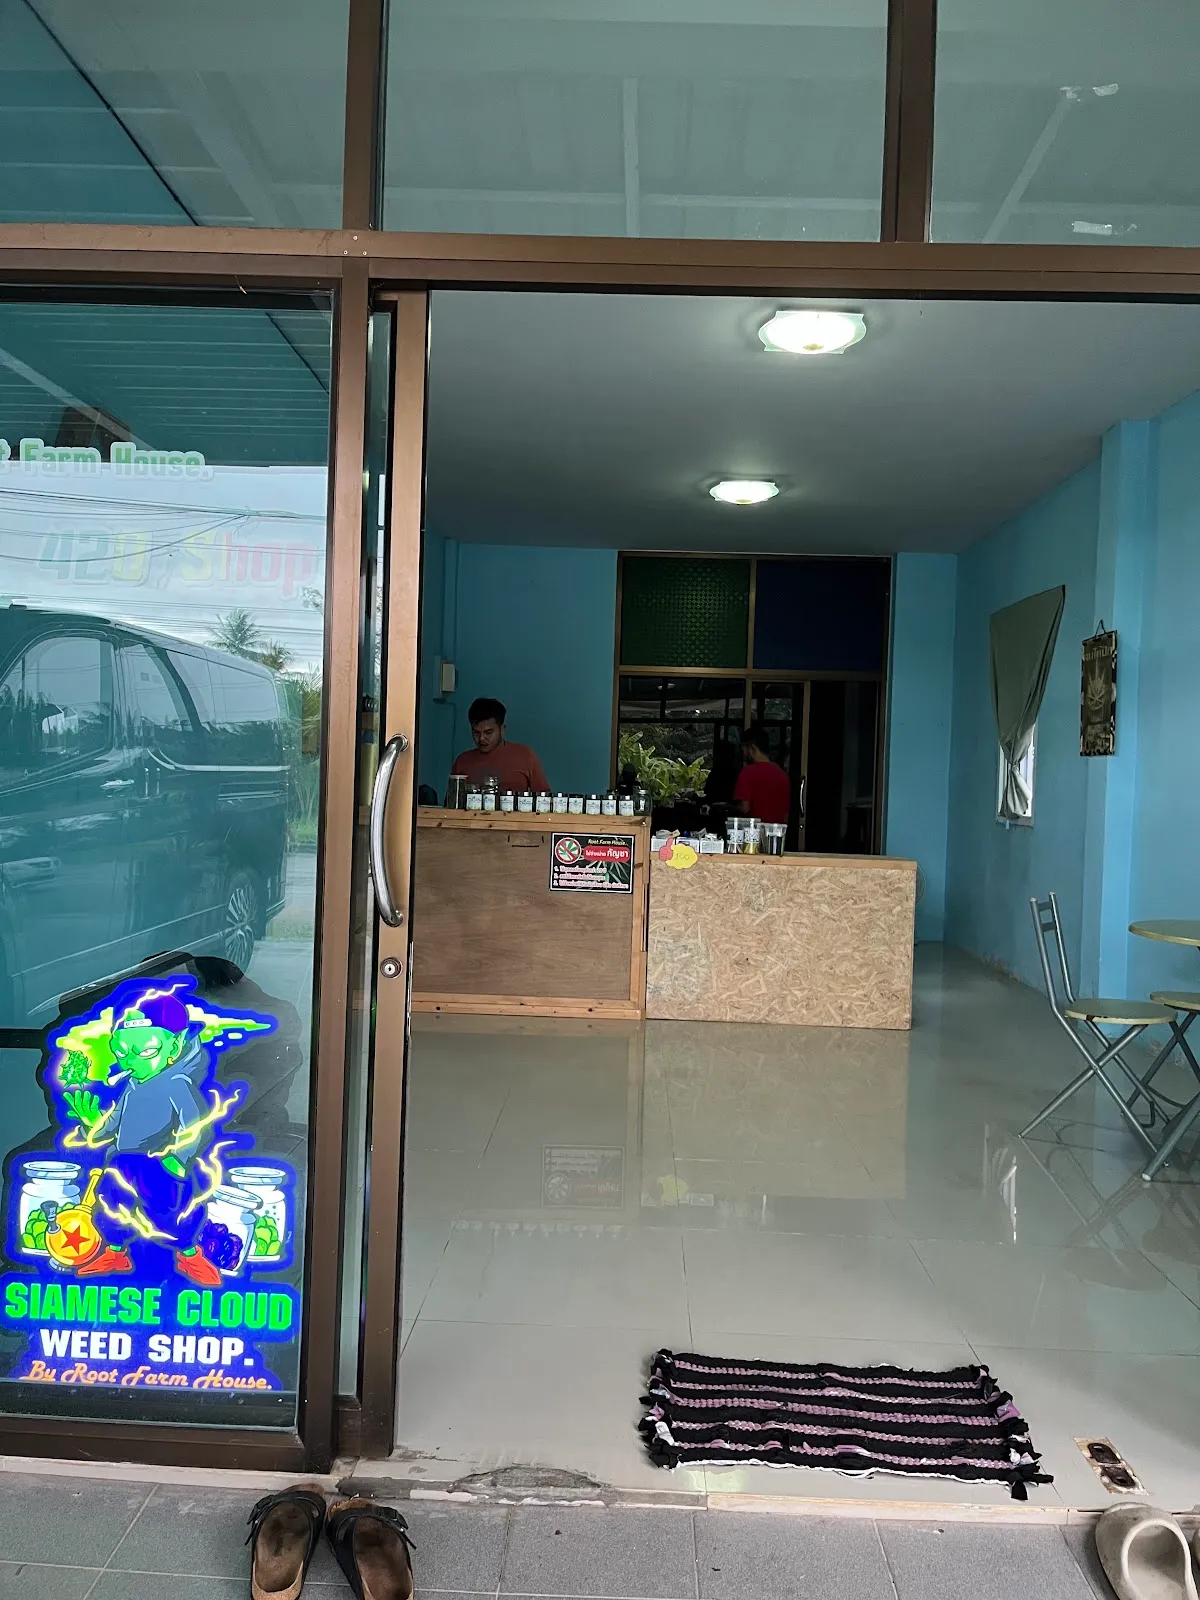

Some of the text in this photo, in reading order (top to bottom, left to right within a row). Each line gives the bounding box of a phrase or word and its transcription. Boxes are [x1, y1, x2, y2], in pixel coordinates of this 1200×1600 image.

[24, 443, 97, 473] Farm
[115, 447, 209, 478] House.
[181, 529, 315, 596] Shop
[607, 848, 629, 859] กัญชา
[5, 1282, 293, 1330] SIAMESE CLOUD
[40, 1328, 254, 1366] WEED SHOP.
[19, 1360, 273, 1390] By Root Farm House.
